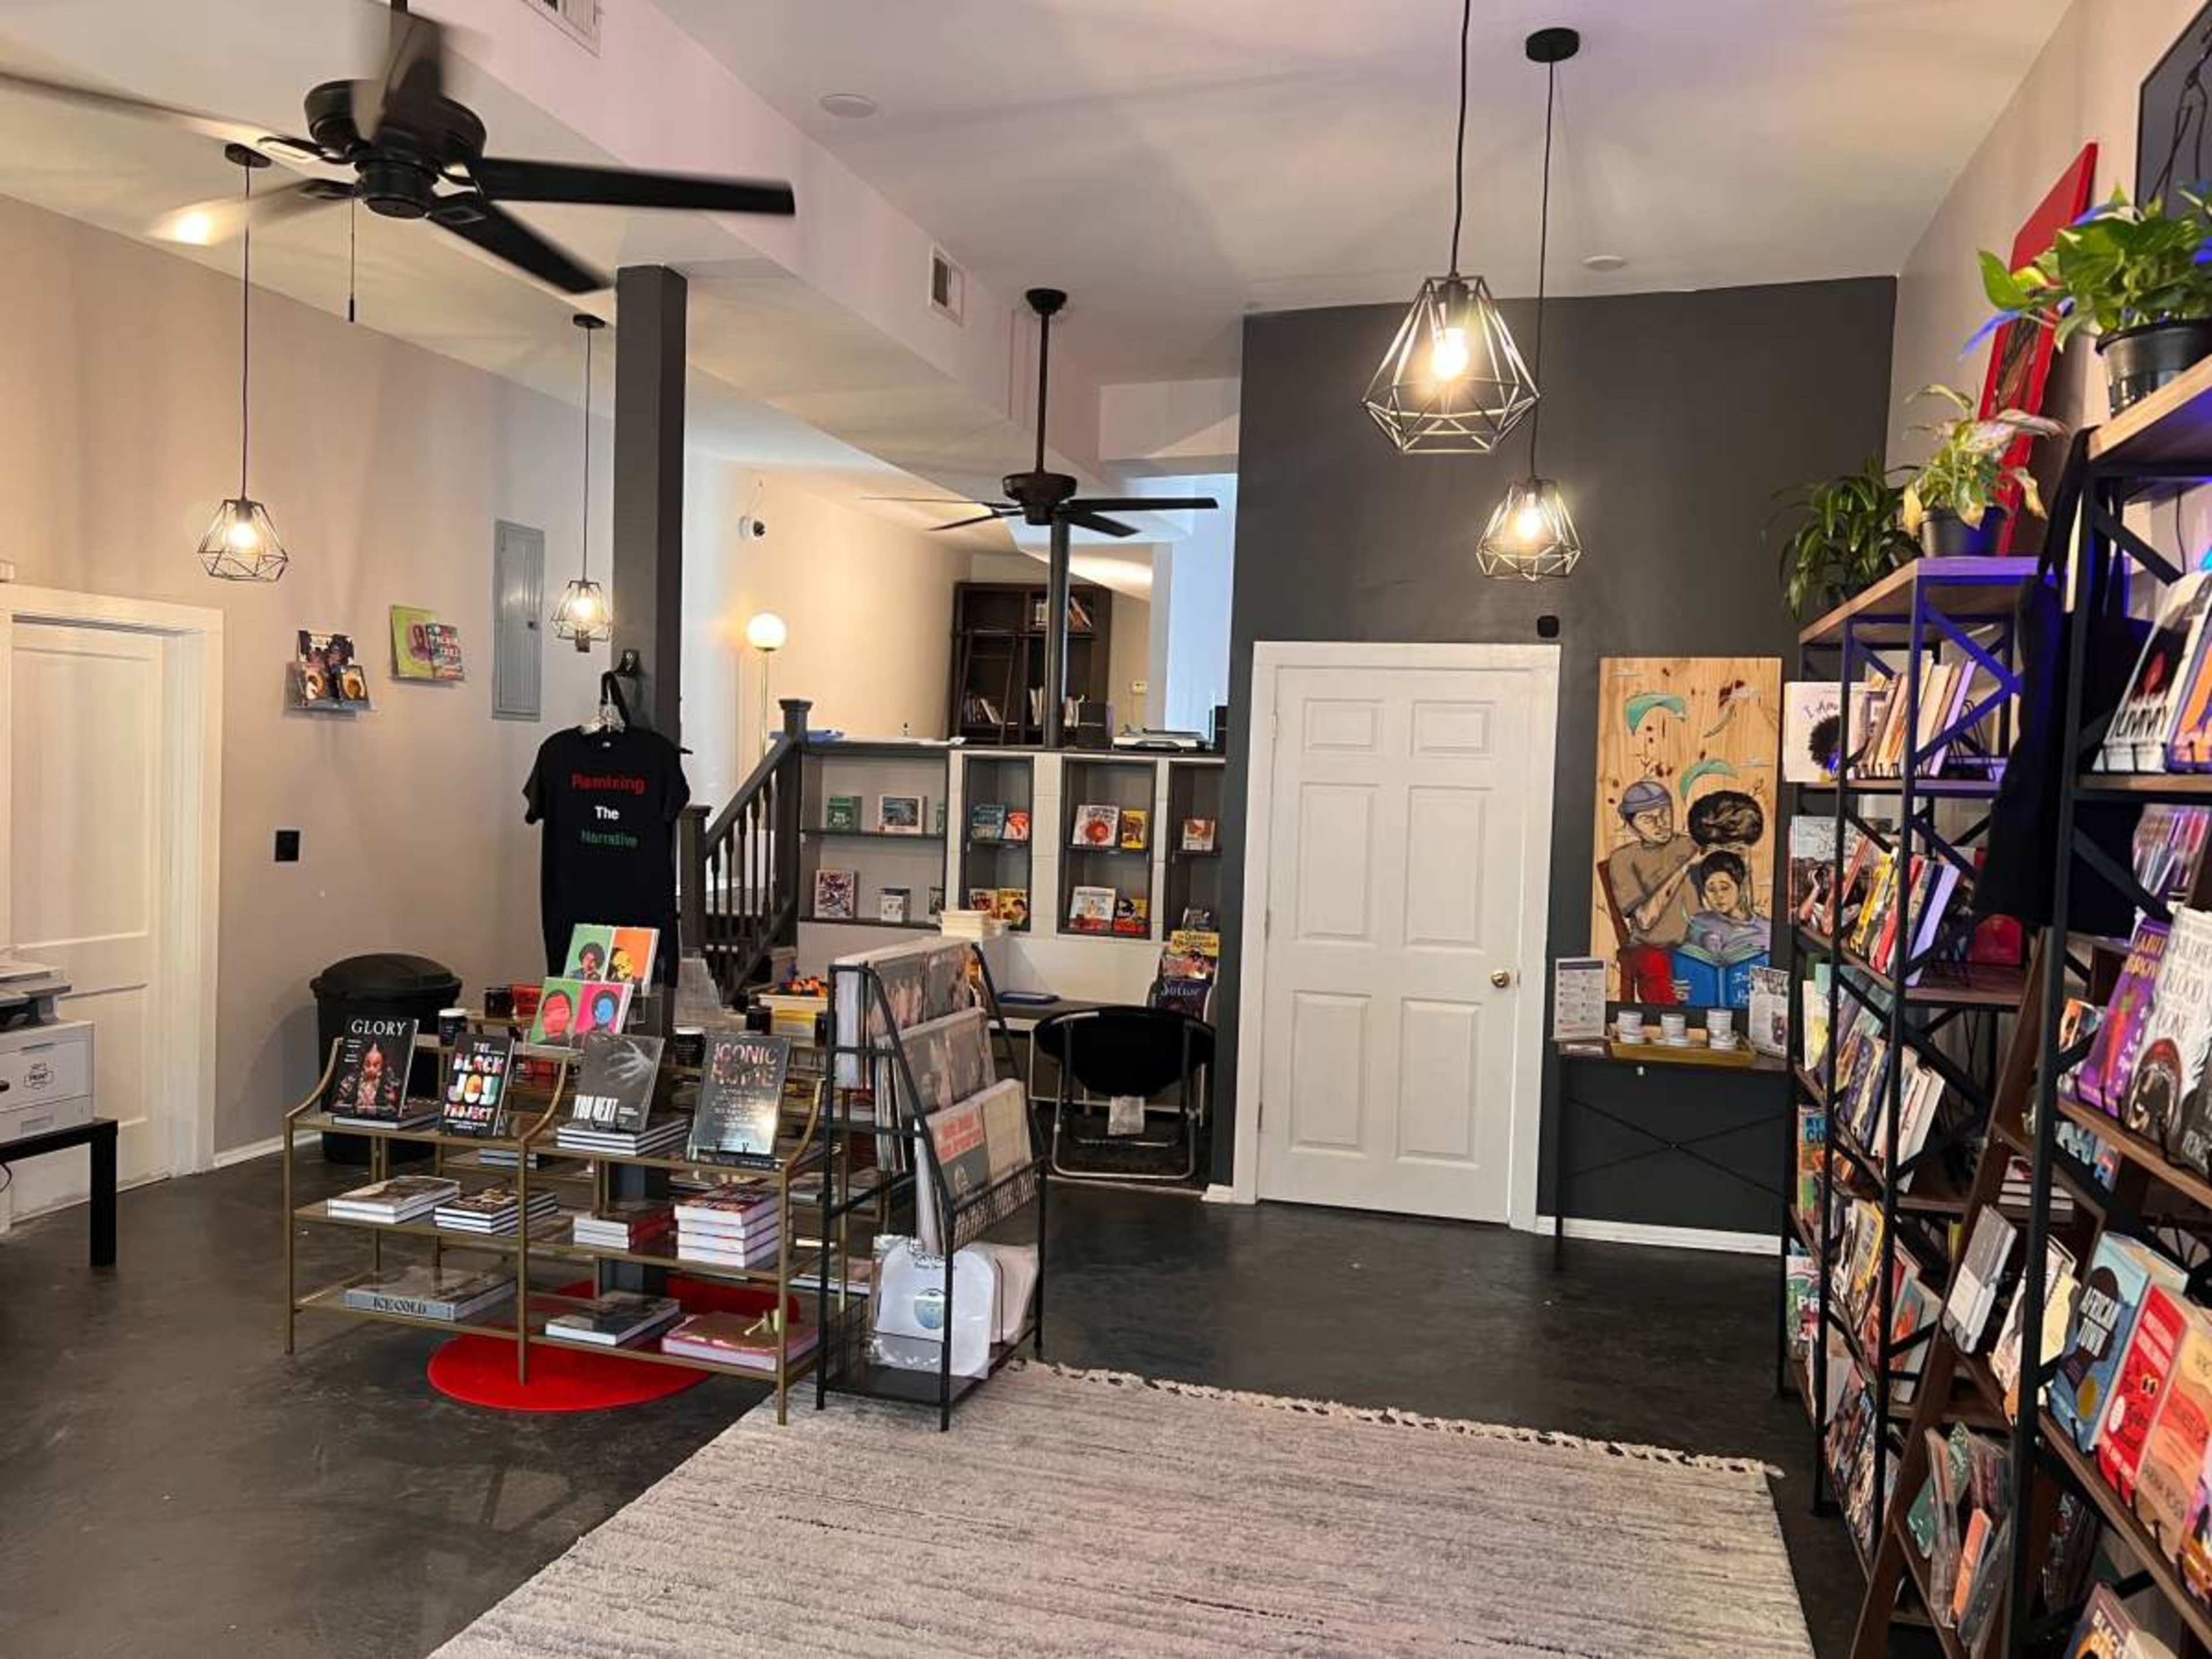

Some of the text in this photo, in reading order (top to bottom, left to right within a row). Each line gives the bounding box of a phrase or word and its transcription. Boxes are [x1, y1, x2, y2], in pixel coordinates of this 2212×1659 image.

[594, 805, 620, 820] The
[581, 830, 638, 847] Narrative
[351, 1018, 406, 1036] GLORY
[453, 1052, 504, 1074] BLACK
[714, 1042, 777, 1065] ICONIC
[448, 1073, 501, 1107] JOY
[593, 1096, 618, 1123] NEXT
[373, 1297, 427, 1315] ICE COLD
